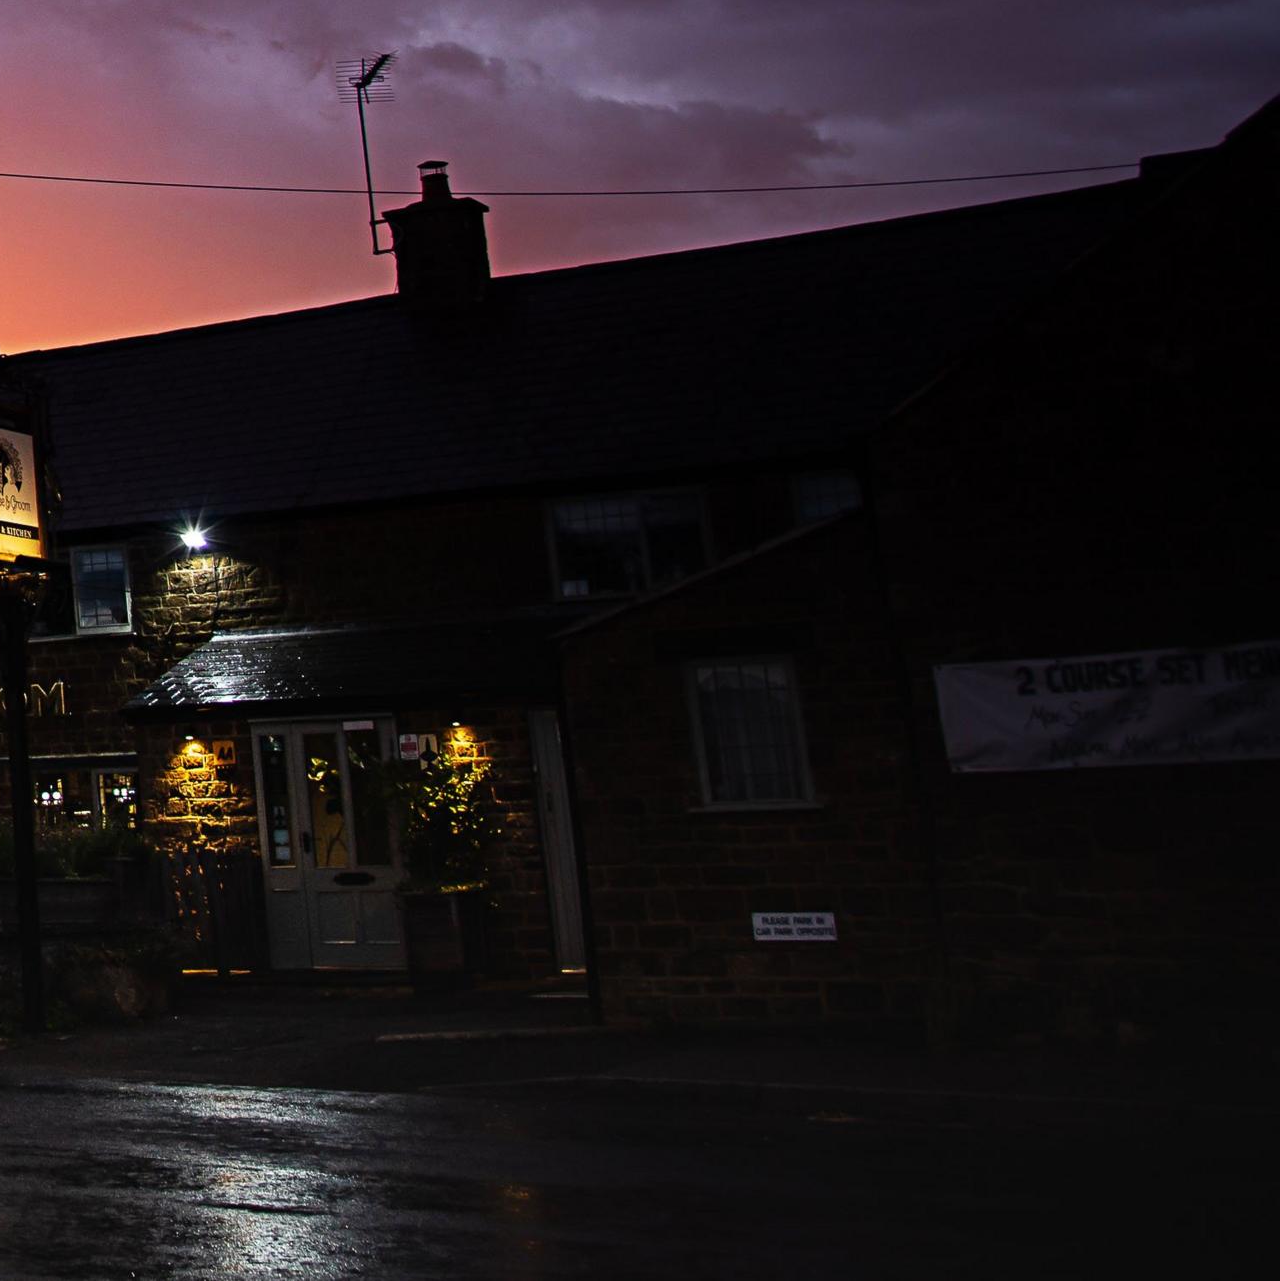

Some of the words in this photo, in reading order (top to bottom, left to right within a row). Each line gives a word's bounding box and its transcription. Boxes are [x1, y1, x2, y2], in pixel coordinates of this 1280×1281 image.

[10, 494, 32, 514] Groom
[6, 526, 32, 538] KITCHEN
[1015, 666, 1037, 696] 2
[1044, 658, 1146, 693] COURSE
[1156, 653, 1206, 684] SET
[217, 747, 233, 760] AA
[761, 916, 790, 925] PLEASE
[793, 916, 813, 924] PARK
[755, 927, 771, 936] CAR
[774, 927, 794, 936] PARK
[796, 927, 836, 936] OPPOSITE
